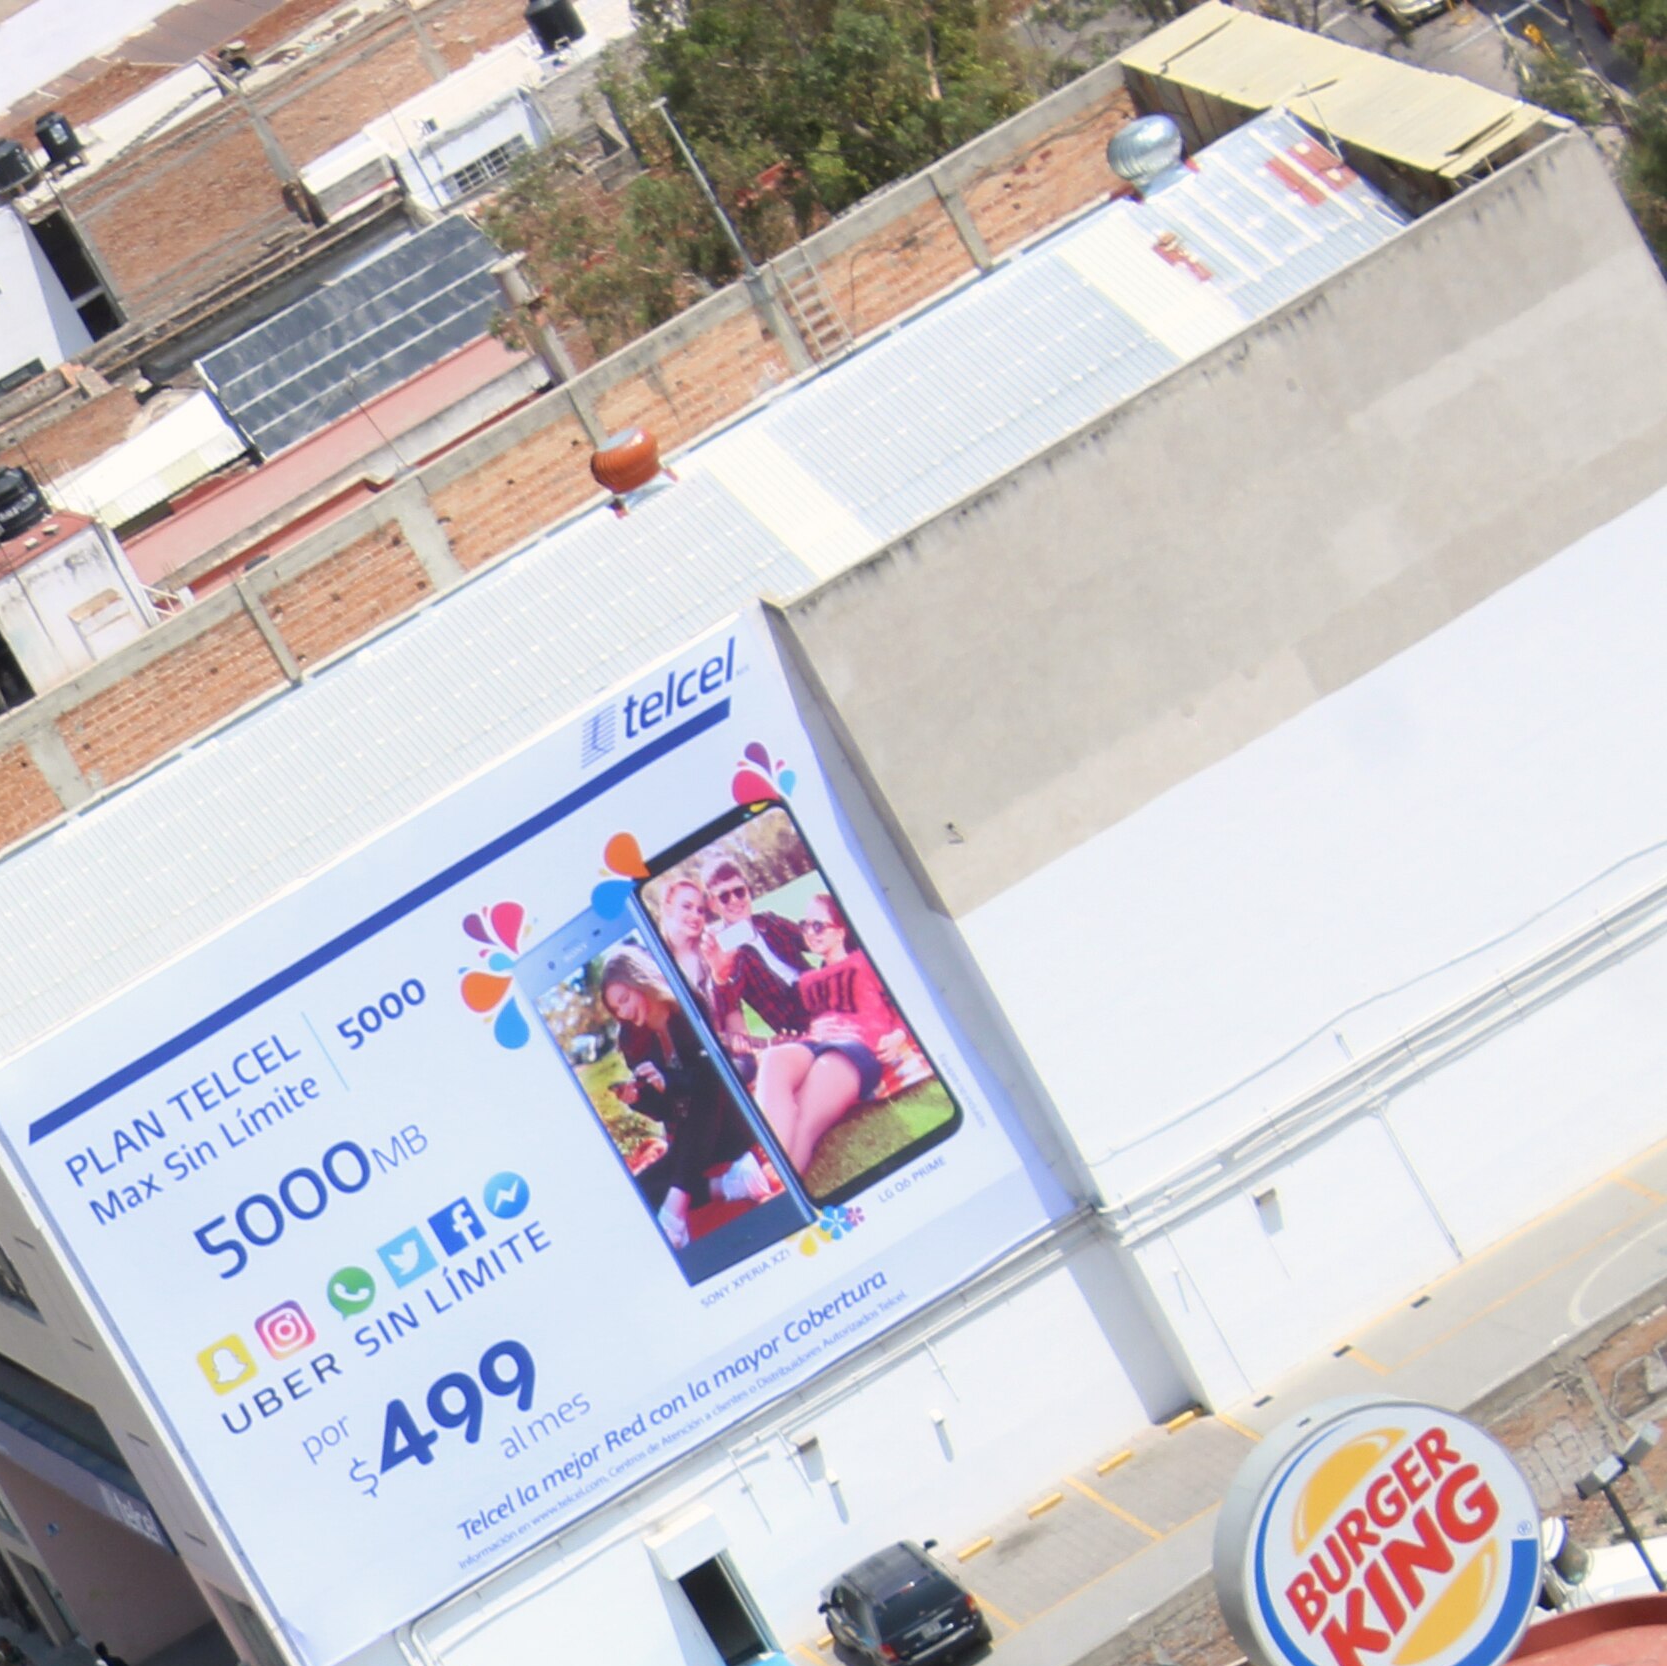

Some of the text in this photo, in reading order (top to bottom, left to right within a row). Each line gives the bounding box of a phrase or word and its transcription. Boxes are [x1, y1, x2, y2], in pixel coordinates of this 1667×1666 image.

[622, 635, 736, 740] telcel
[335, 976, 429, 1052] 5000
[64, 1033, 302, 1188] PLAN TELCEL
[89, 1075, 321, 1226] Max Sin Límite
[877, 1188, 895, 1203] LG
[912, 1155, 946, 1181] PRIME
[192, 1123, 429, 1281] 5000 MB
[220, 1219, 552, 1436] UBER SIN LÍMITE
[700, 1285, 732, 1309] SONY
[731, 1260, 772, 1290] XPERIA
[301, 1413, 350, 1465] por
[349, 1339, 536, 1499] $499
[456, 1269, 888, 1542] Telcel la mejor Red con la mayor Cobertura
[458, 1530, 518, 1570] Información
[516, 1522, 532, 1536] en
[608, 1449, 648, 1478] Centros
[646, 1441, 660, 1456] de
[660, 1416, 706, 1448] Atención
[711, 1390, 750, 1417] clientes
[755, 1344, 823, 1389] Distribuidores
[822, 1310, 880, 1348] Autorizados
[499, 1392, 592, 1461] al mes
[1284, 1426, 1462, 1636] BURGER
